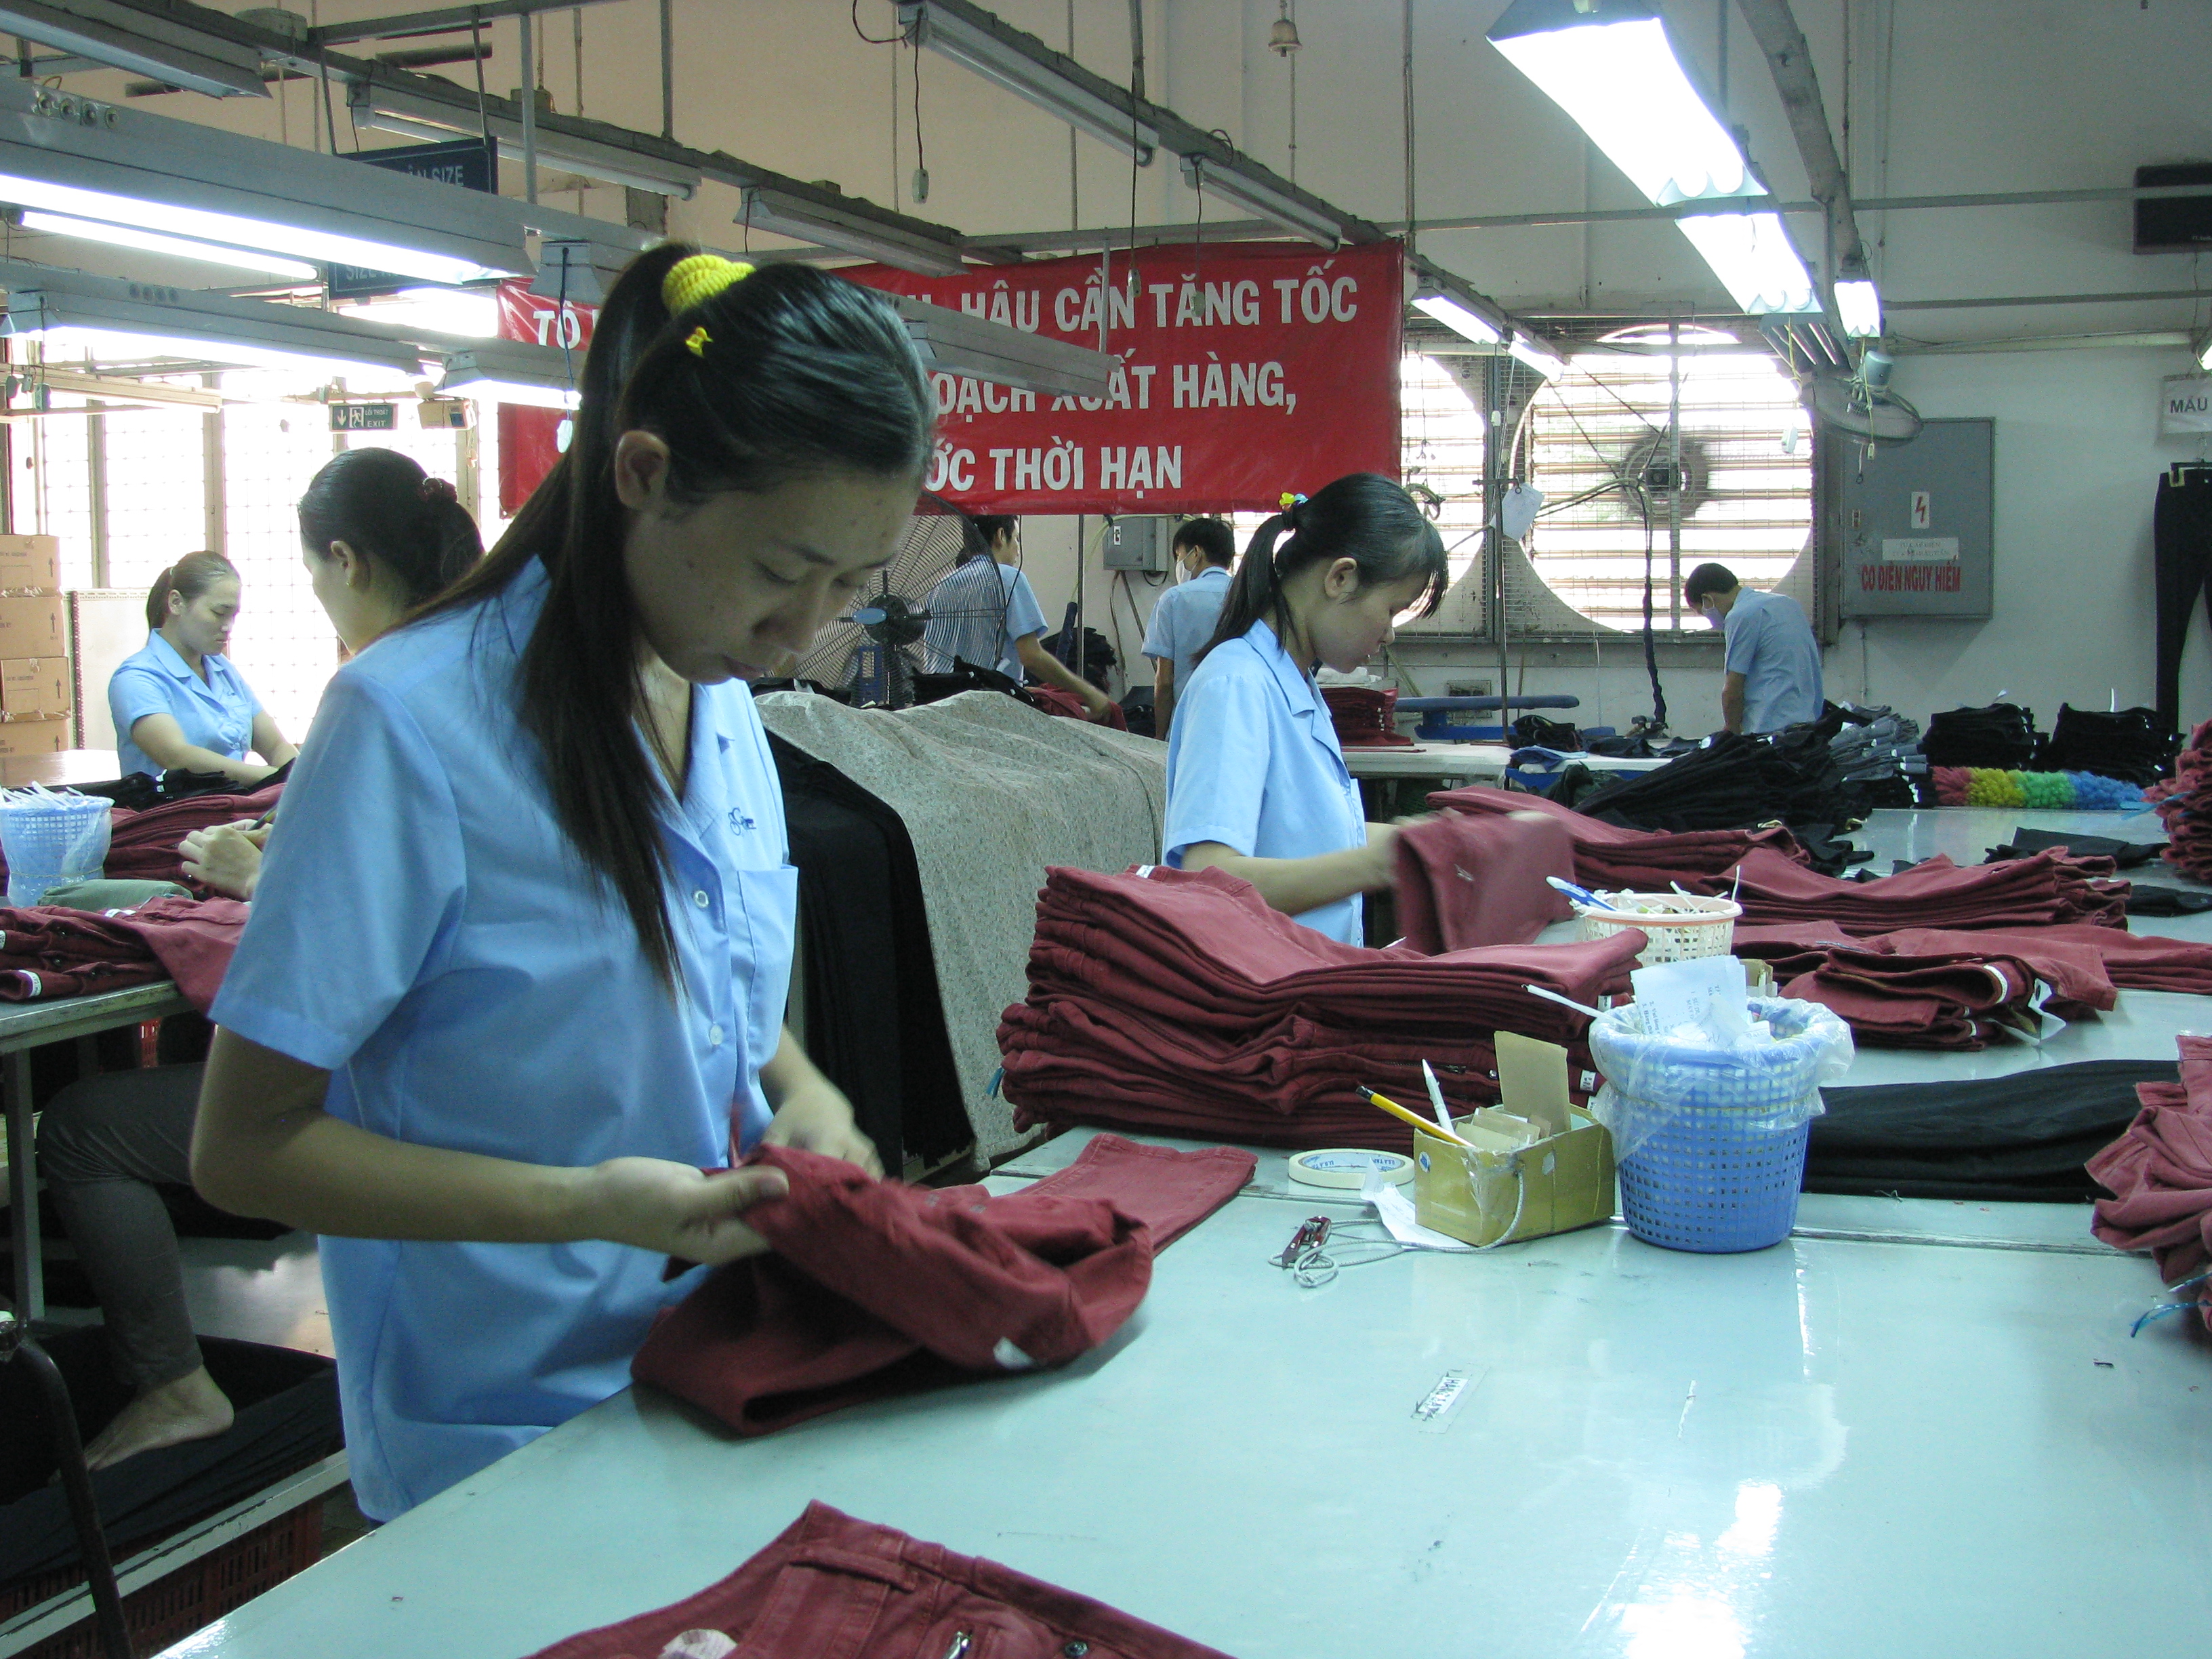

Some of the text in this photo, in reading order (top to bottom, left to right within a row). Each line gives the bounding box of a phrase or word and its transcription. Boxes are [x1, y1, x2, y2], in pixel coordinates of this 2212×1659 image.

[533, 300, 581, 350] TÔ
[1054, 267, 1135, 332] CẦN
[1148, 272, 1260, 328] TĂNG
[1273, 259, 1357, 324] TỐC
[1172, 351, 1296, 415] HÀNG,
[367, 419, 387, 428] EXIT
[989, 435, 1084, 491] THỜI
[1099, 445, 1182, 499] HẠN
[1904, 565, 1933, 592] NGUY
